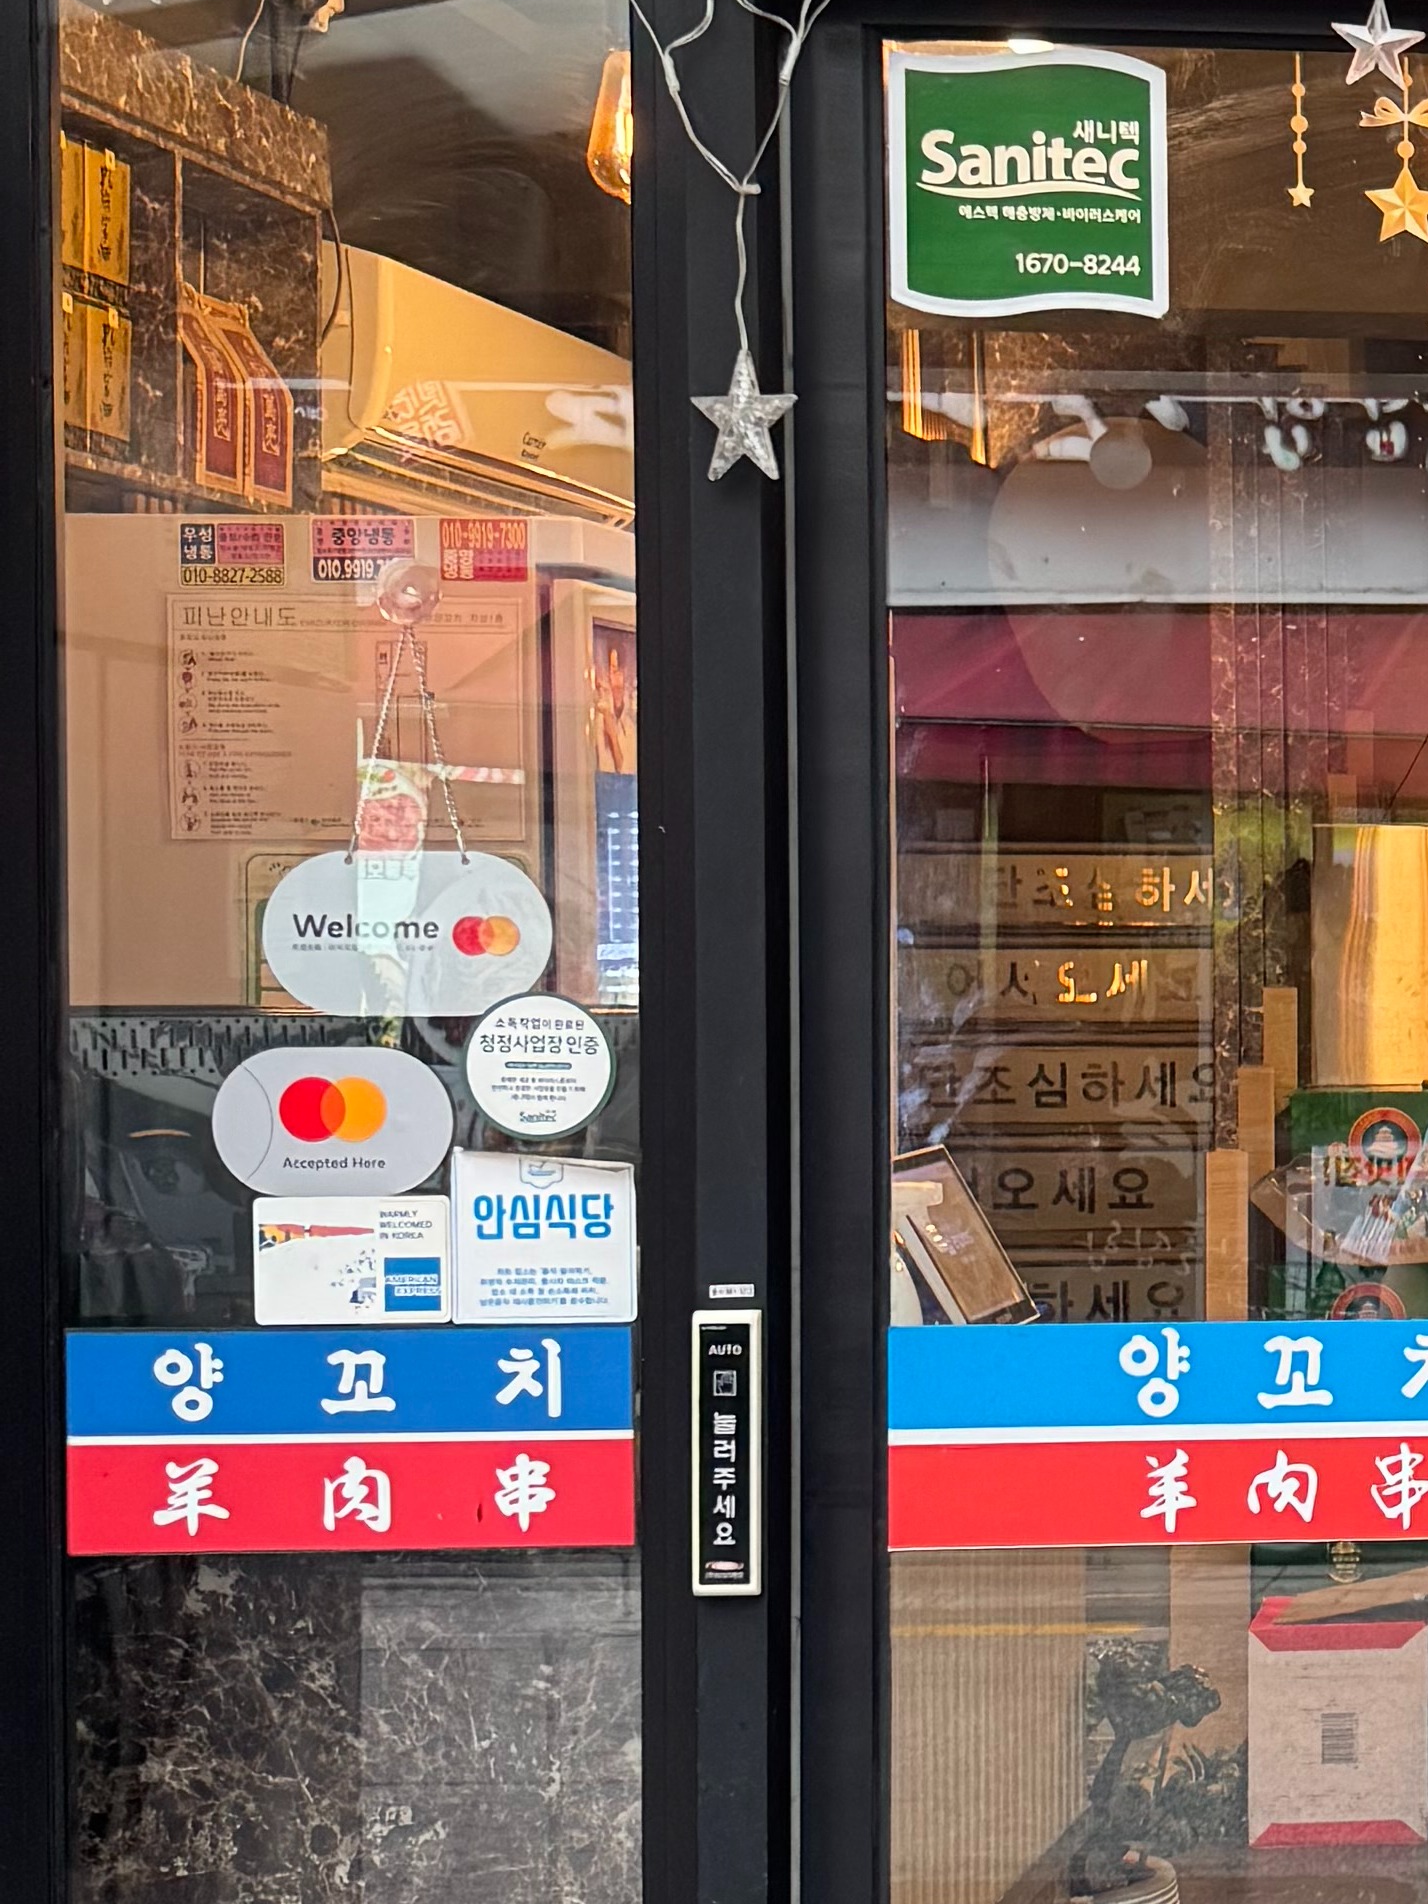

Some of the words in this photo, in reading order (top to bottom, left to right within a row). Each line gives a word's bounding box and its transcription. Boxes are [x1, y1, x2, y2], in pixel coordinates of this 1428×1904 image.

[1072, 120, 1140, 146] 새니텍
[920, 129, 1141, 190] Sanitec
[1015, 252, 1141, 276] 1670-8244
[183, 567, 282, 584] 010-8827-2588
[182, 606, 297, 627] 피난안내도
[293, 912, 440, 940] Welcome
[480, 1034, 562, 1054] 청정사업장
[566, 1035, 600, 1056] 인증
[282, 1157, 348, 1171] Accepted
[352, 1157, 386, 1169] Here
[473, 1193, 614, 1240] 안심식당
[385, 1275, 438, 1284] AMERICAN
[708, 1343, 743, 1356] AUTO
[154, 1339, 560, 1421] 양꼬치
[712, 1411, 737, 1546] 눌러주세요
[154, 1454, 555, 1535] 羊肉串
